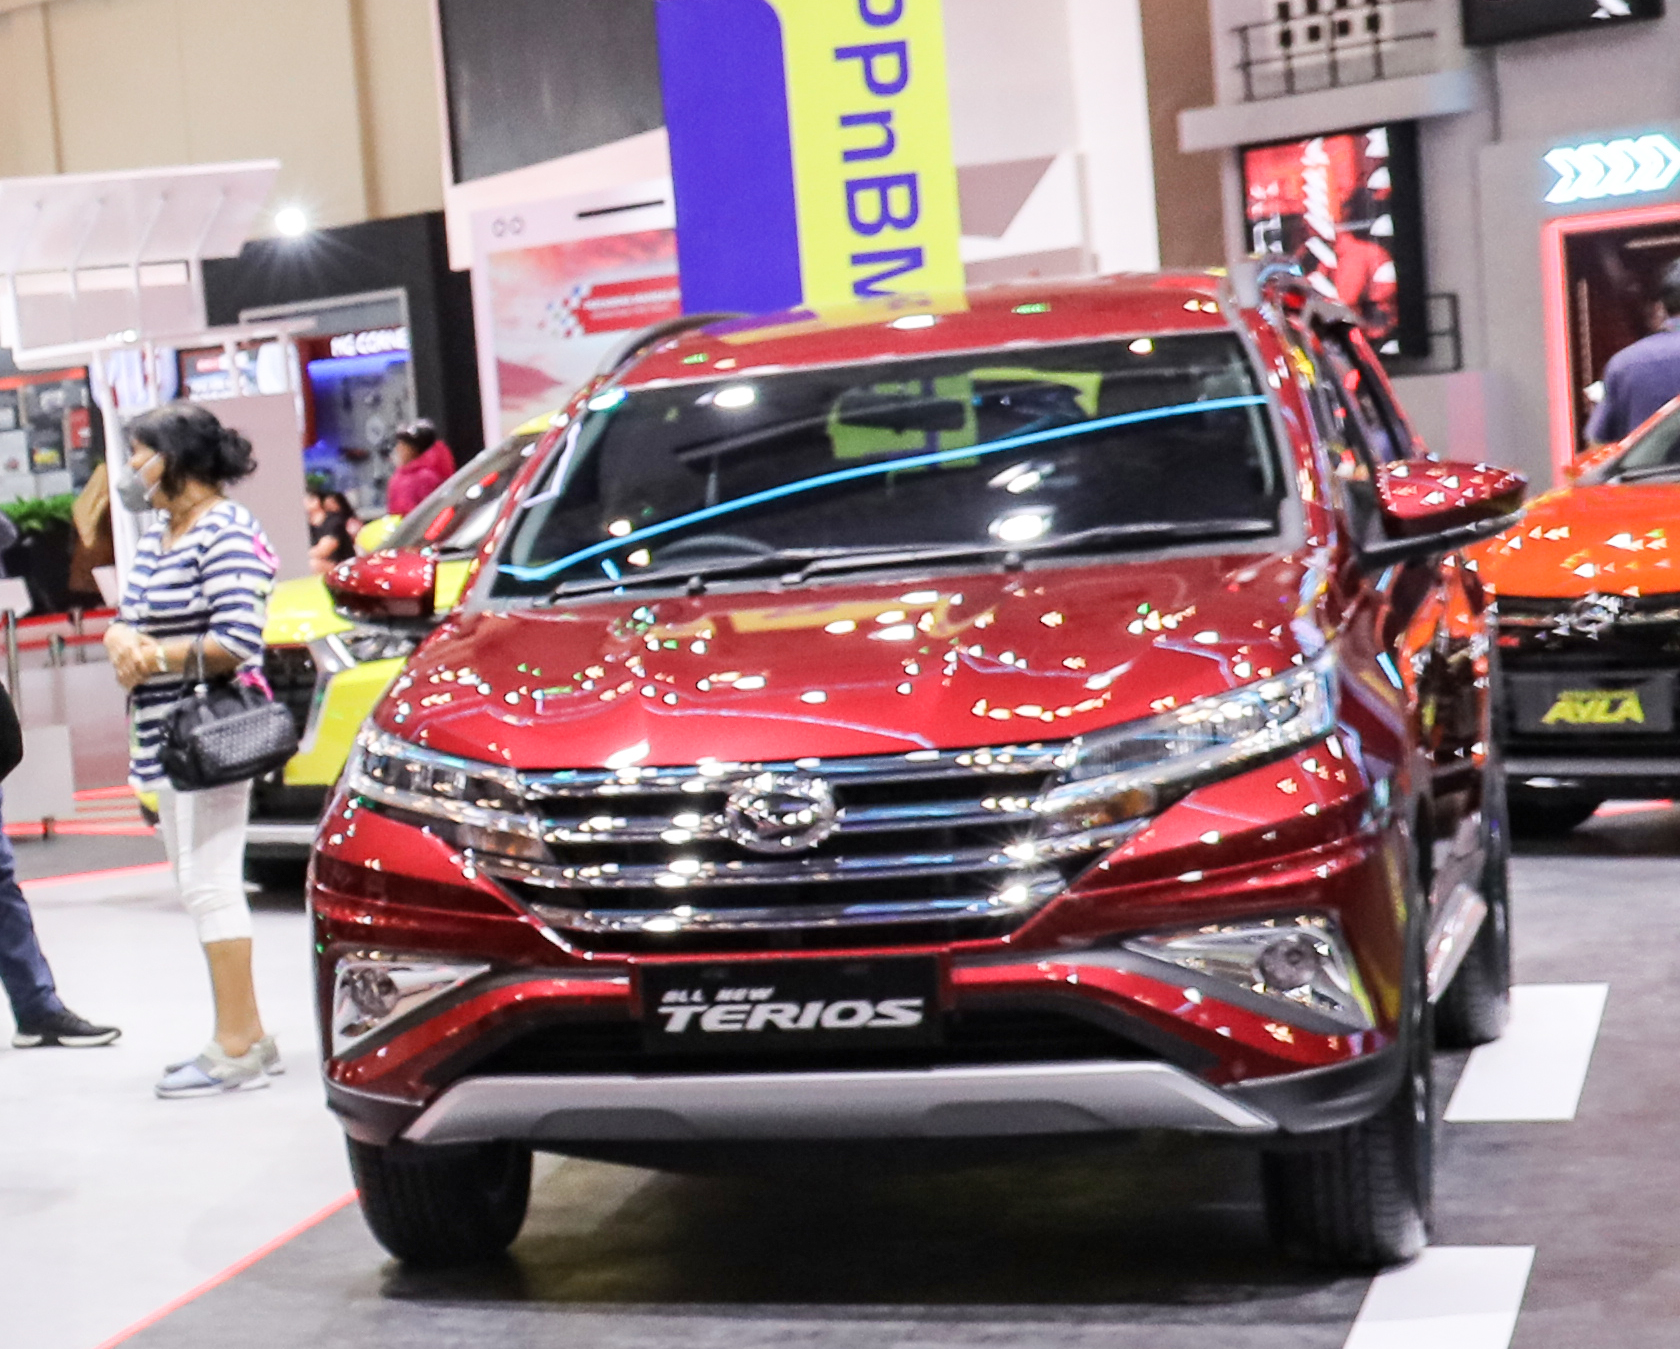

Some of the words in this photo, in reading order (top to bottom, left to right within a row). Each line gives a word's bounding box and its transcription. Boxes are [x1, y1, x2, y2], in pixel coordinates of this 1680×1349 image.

[662, 988, 704, 1003] ALL
[714, 986, 776, 1002] NEW
[657, 996, 925, 1033] TERIOS
